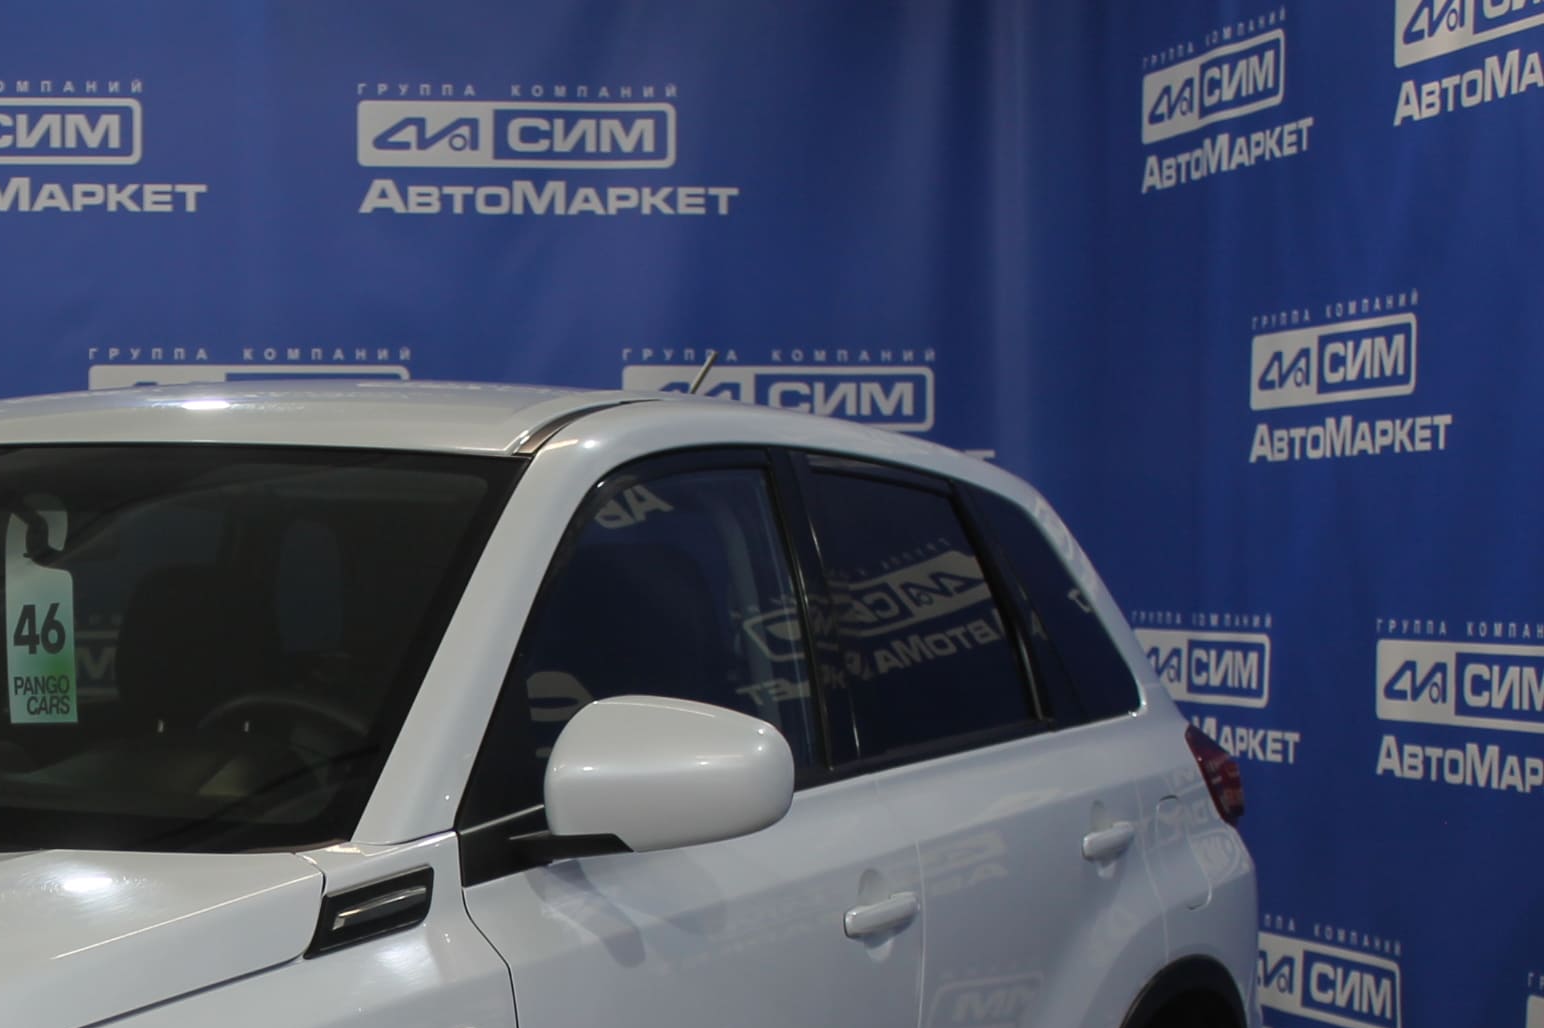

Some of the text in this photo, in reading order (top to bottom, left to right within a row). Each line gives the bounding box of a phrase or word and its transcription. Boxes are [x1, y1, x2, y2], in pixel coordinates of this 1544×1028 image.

[358, 83, 677, 98] ГРУППА КОМПАНИЙ
[1203, 49, 1275, 107] СИМ
[508, 118, 655, 152] СИМ
[89, 347, 410, 360] ГРУППА КОМПАНИЙ
[772, 349, 935, 361] КОМПАНИЙ
[1323, 333, 1405, 384] СИМ
[768, 380, 915, 416] СИМ
[14, 603, 66, 655] 46
[1377, 619, 1446, 634] ГРУППА
[14, 676, 70, 695] PANGO
[1191, 648, 1259, 690] СИМ
[27, 695, 70, 715] CARS
[1309, 961, 1393, 1020] СИМ
